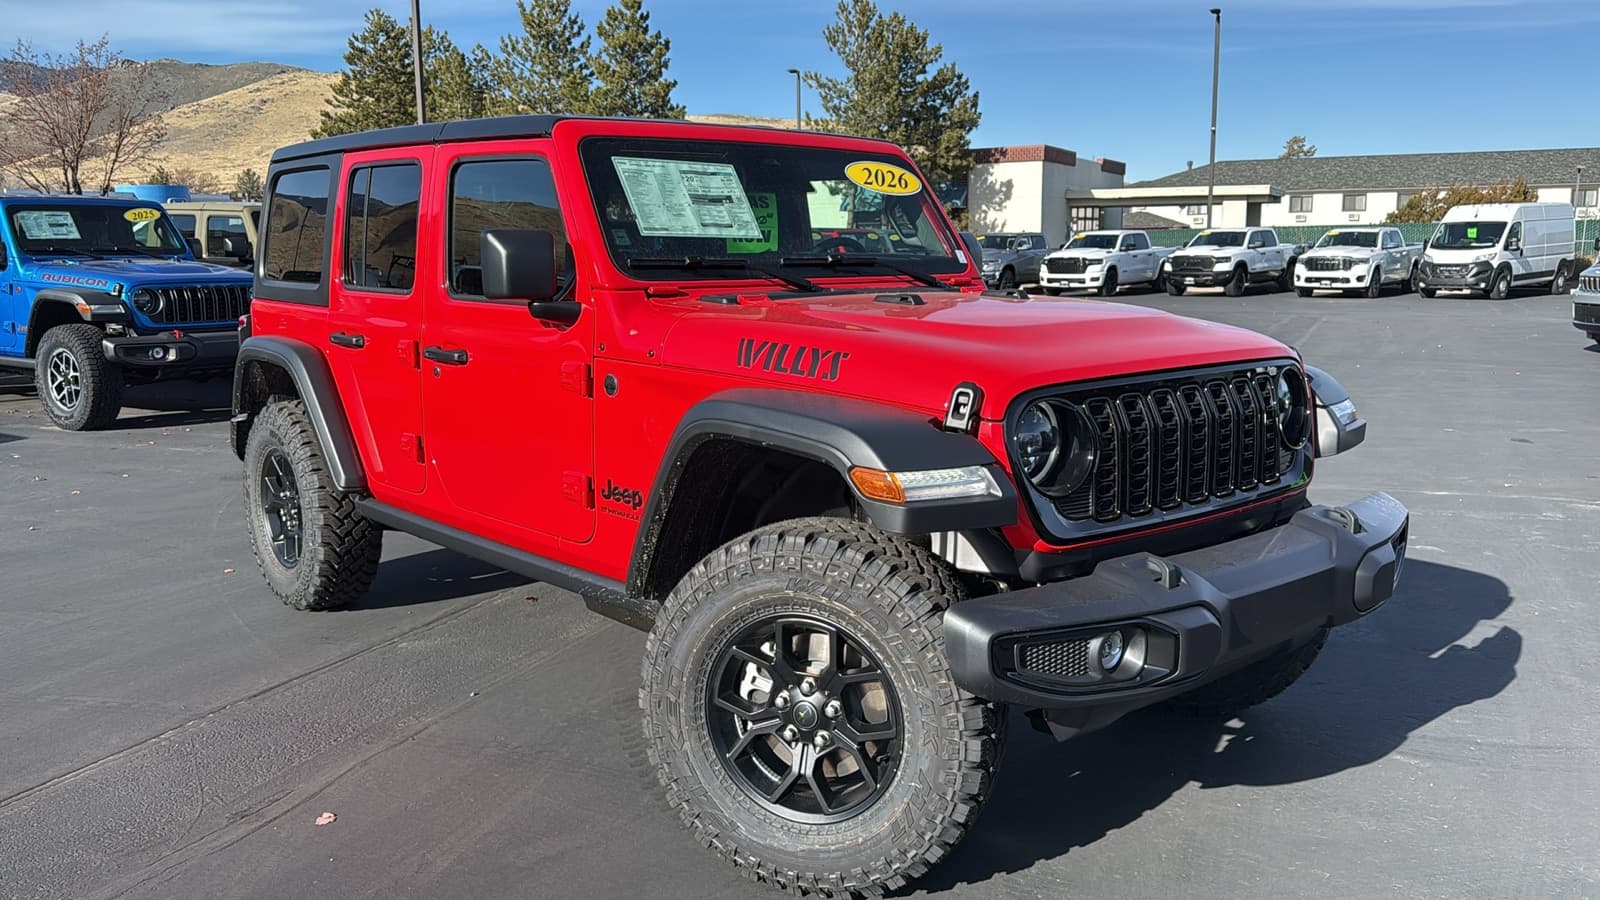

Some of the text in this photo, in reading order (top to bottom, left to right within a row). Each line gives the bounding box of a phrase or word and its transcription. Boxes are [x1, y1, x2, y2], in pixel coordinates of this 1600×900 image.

[862, 167, 909, 190] 2026
[132, 210, 154, 220] 2025
[41, 273, 109, 287] RUBICON
[737, 337, 850, 382] WILLYS
[601, 479, 643, 510] Jeep
